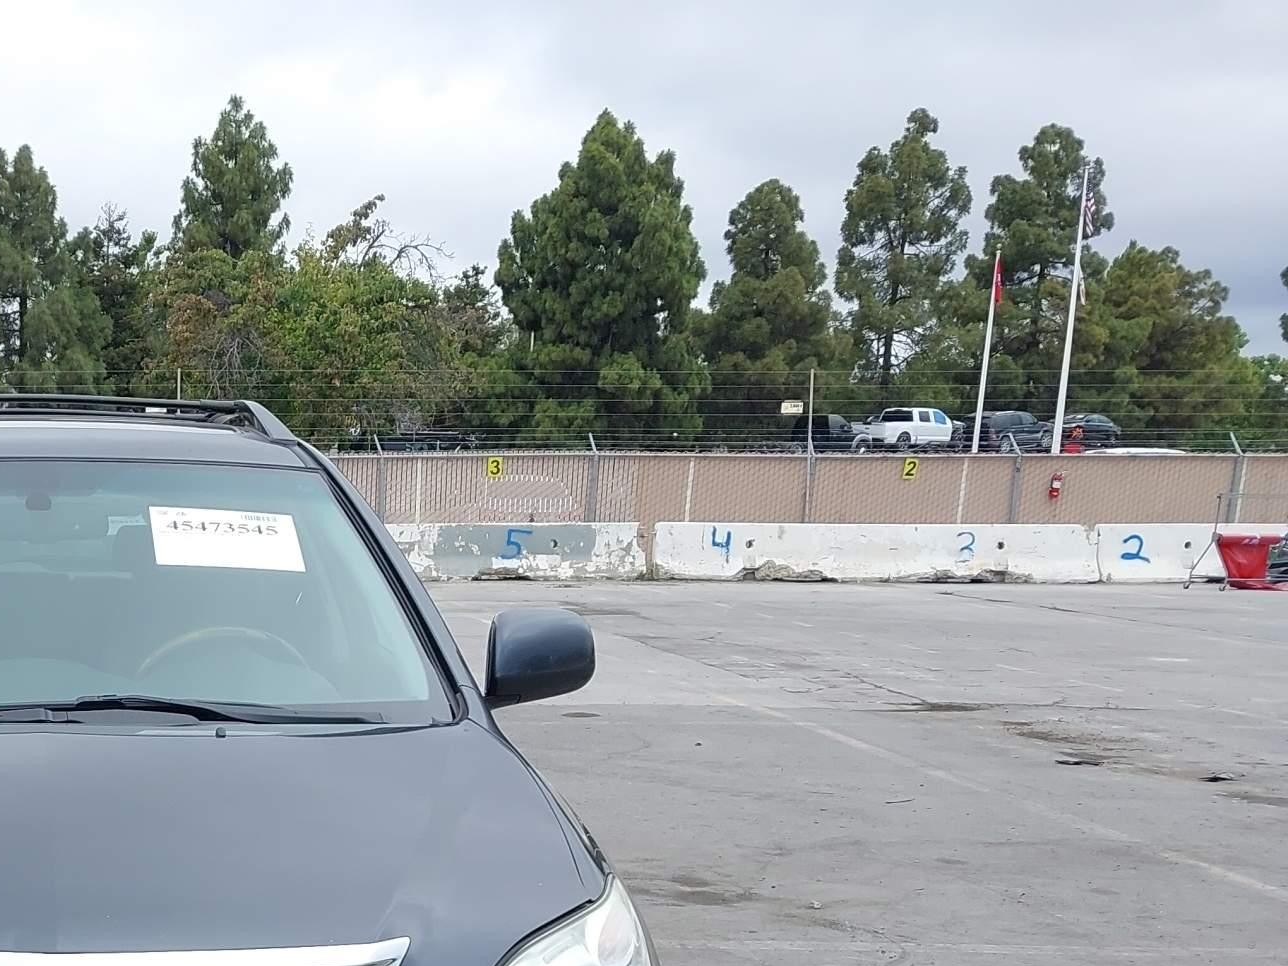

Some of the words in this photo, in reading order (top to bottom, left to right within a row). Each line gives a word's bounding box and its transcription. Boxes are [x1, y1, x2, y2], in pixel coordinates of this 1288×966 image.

[489, 460, 501, 476] 3
[904, 461, 918, 477] 2
[166, 520, 279, 535] 45473545
[500, 528, 533, 560] 5
[712, 526, 731, 563] 4
[1120, 534, 1150, 563] 2
